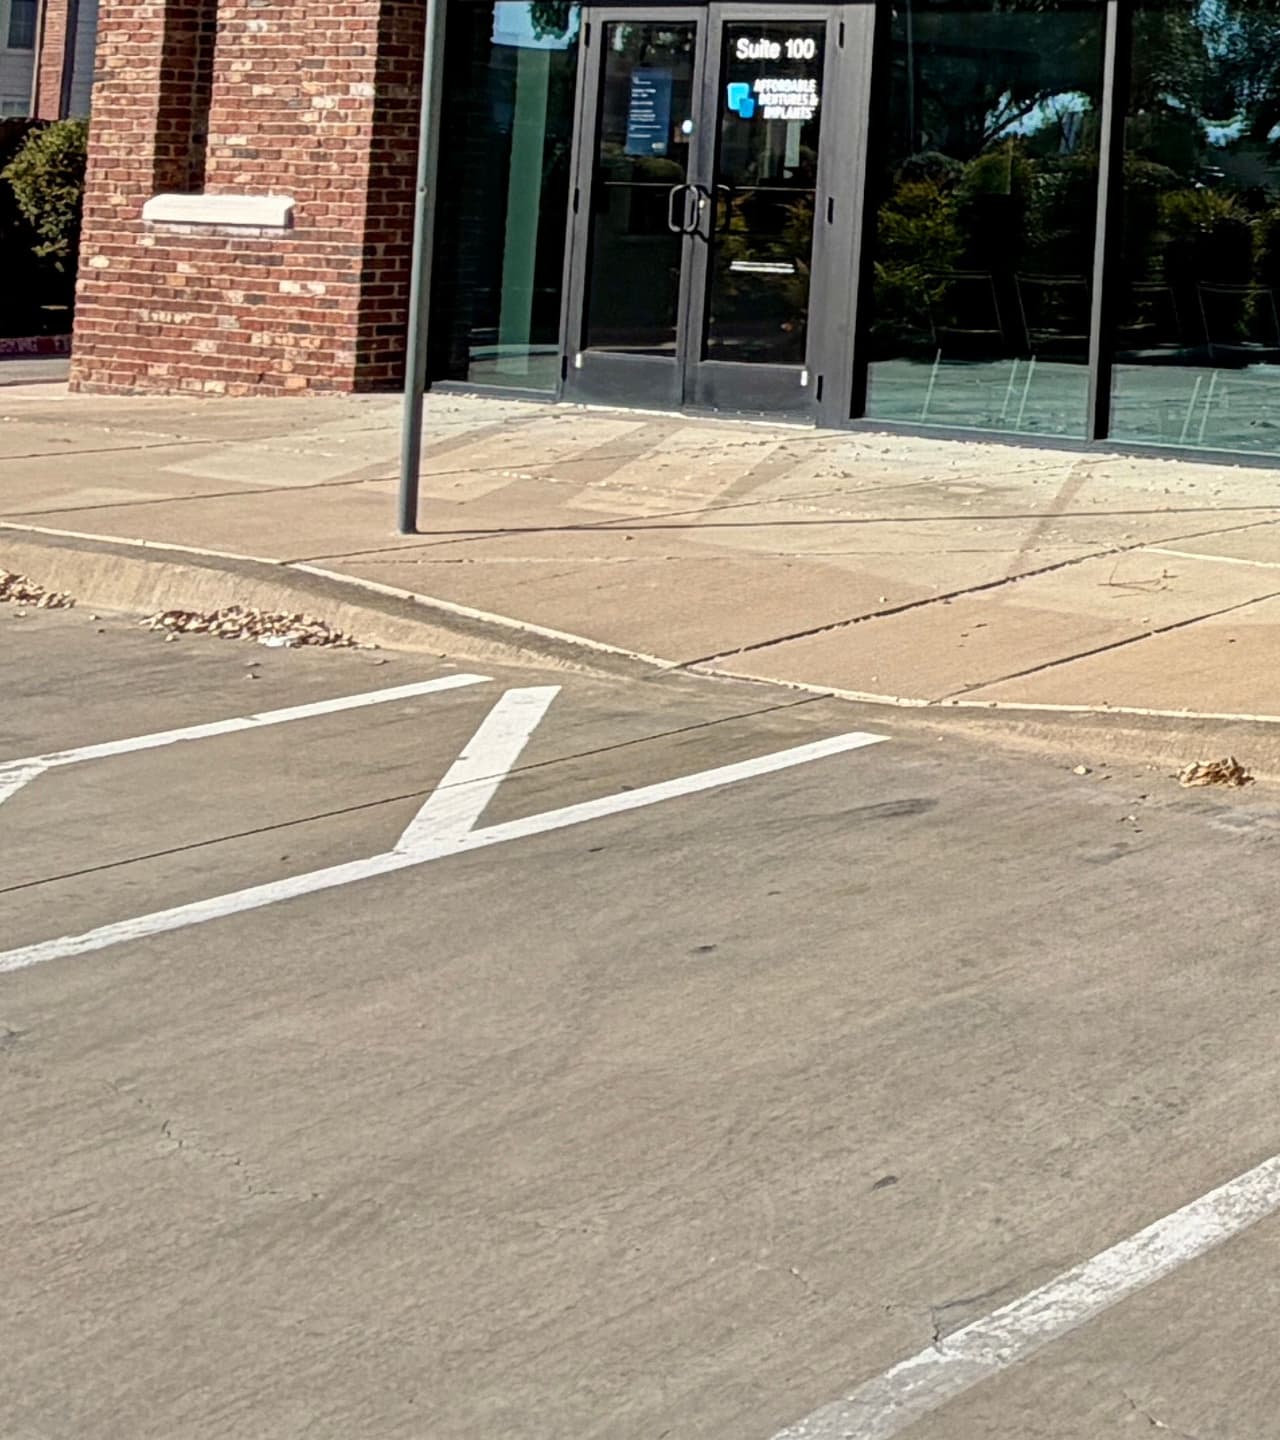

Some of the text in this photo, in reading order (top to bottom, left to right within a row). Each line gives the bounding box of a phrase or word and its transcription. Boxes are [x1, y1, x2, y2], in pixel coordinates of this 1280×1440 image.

[736, 38, 815, 59] Suite 100
[753, 79, 817, 93] AFFORDABLE
